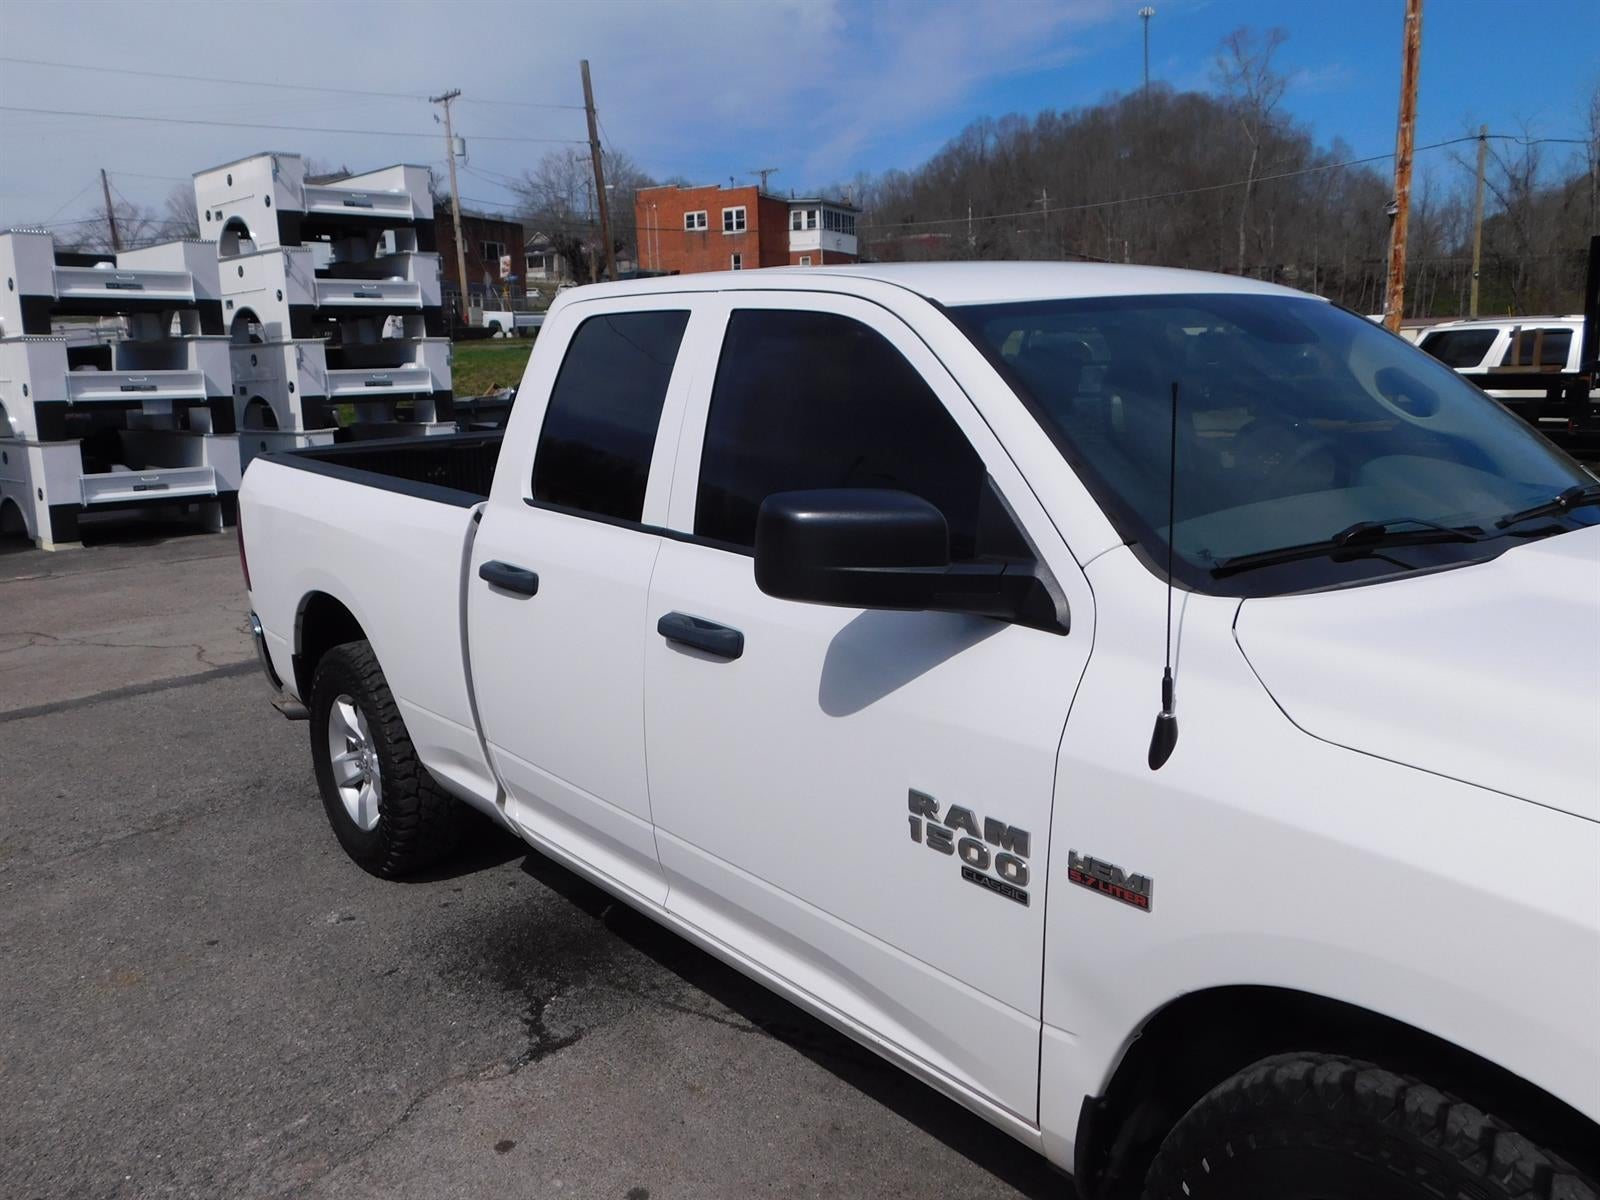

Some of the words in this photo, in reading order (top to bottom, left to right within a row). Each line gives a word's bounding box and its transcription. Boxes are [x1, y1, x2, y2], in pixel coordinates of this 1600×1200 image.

[908, 787, 1031, 858] RAM
[908, 815, 1030, 887] 1500
[1068, 848, 1153, 896] HEMI
[962, 867, 1029, 905] CLASSIC
[1069, 868, 1097, 887] 5.7
[1098, 882, 1149, 907] LITER
